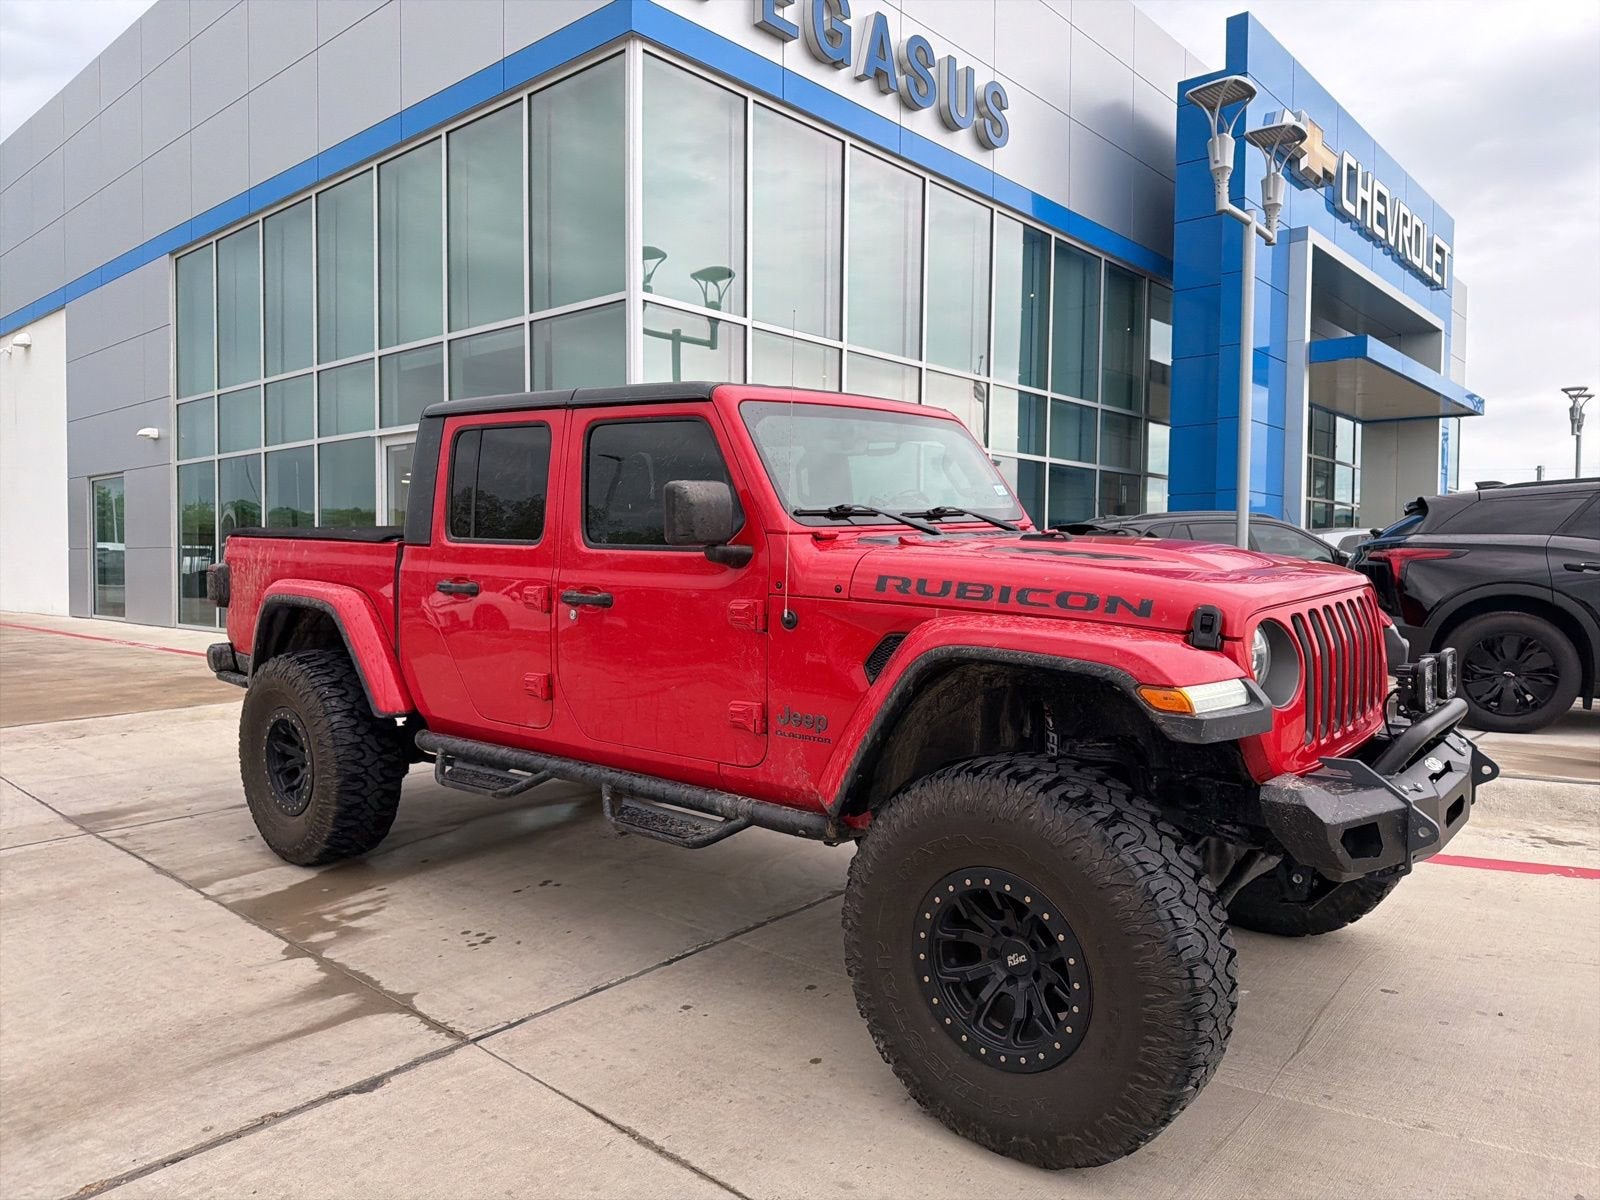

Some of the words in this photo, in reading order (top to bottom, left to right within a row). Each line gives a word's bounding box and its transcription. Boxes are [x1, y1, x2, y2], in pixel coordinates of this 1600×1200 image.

[1335, 150, 1453, 290] CHEVROLET
[875, 575, 1153, 618] RUBICON
[775, 729, 833, 745] GLADIATOR
[776, 705, 829, 734] Jeep
